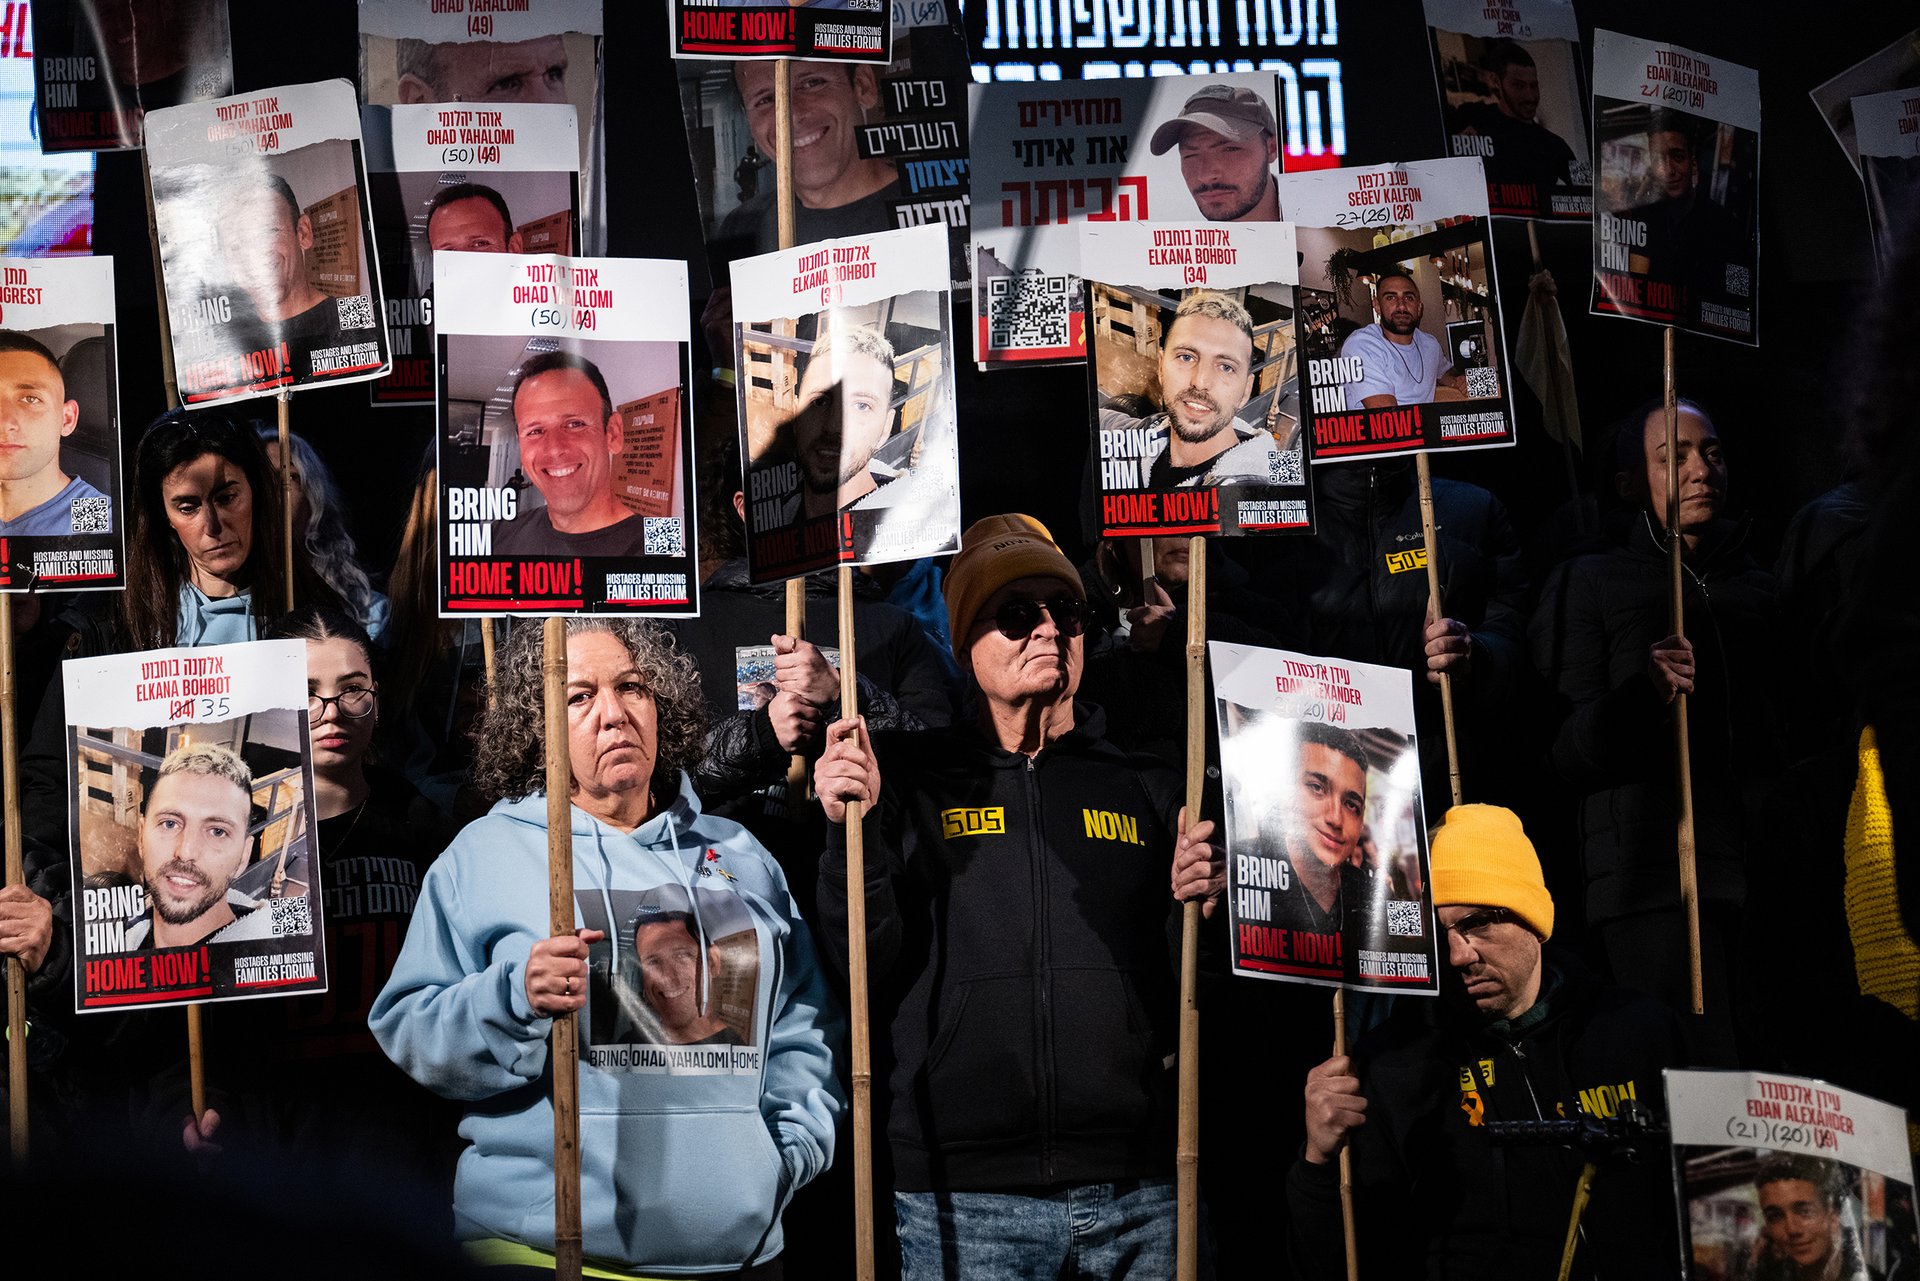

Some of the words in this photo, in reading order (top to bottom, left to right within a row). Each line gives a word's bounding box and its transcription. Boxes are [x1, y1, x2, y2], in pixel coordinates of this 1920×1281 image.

[431, 0, 464, 13] OHAD
[468, 0, 529, 12] YAHALOMI
[1483, 7, 1501, 20] ITAY
[467, 15, 493, 37] (49)
[683, 12, 737, 40] HOME
[741, 9, 796, 41] NOW!
[814, 24, 844, 34] HOSTAGES
[844, 25, 856, 35] AND
[856, 26, 882, 36] MISSING
[814, 33, 851, 49] FAMILIES
[852, 34, 882, 50] FORUM
[43, 57, 96, 81] BRING
[1655, 50, 1692, 71] אלכסנדר
[1693, 62, 1710, 77] עידן
[1647, 65, 1671, 82] EDAN
[1673, 67, 1719, 95] ALEXANDER
[45, 83, 78, 108] HIM
[252, 97, 279, 116] אוהד
[891, 80, 947, 113] פדיון
[216, 102, 250, 122] יהלומי
[438, 110, 473, 127] יהלומי
[475, 112, 502, 127] אוהד
[1018, 97, 1122, 127] מחזירים
[46, 111, 95, 137] HOME
[207, 123, 236, 142] OHAD
[238, 113, 293, 136] YAHALOMI
[1898, 116, 1919, 135] EDAN
[427, 130, 457, 145] OHAD
[459, 129, 515, 144] YAHALOMI
[864, 121, 960, 155] השבויים
[1451, 134, 1495, 157] BRING
[442, 148, 475, 164] (50)
[477, 146, 501, 164] (49)
[1012, 137, 1075, 167] איתי
[1086, 135, 1128, 164] את
[905, 158, 970, 193] יצחון
[1357, 172, 1386, 190] כלפון
[1387, 171, 1409, 186] שגב
[1001, 175, 1149, 227] הביתה
[1348, 190, 1381, 207] SEGEV
[1383, 187, 1422, 204] KALFON
[1500, 182, 1539, 207] NOW!
[1393, 203, 1414, 221] (25)
[1153, 229, 1192, 246] בוחבוט
[1195, 229, 1231, 247] אלקנה
[1600, 210, 1648, 247] BRING
[799, 249, 830, 274] בוחבוט
[833, 245, 870, 264] אלקנה
[1148, 248, 1193, 265] ELKANA
[1194, 248, 1238, 265] BOHBOT
[1601, 241, 1630, 272] HIM
[4, 267, 28, 286] מתן
[527, 264, 566, 283] יהלומי
[568, 267, 599, 287] אוהד
[793, 268, 829, 294] ELKANA
[832, 262, 877, 282] BOHBOT
[1183, 265, 1208, 284] (34)
[513, 286, 549, 304] OHAD
[1600, 272, 1644, 305] HOME
[531, 308, 568, 329] (50)
[571, 307, 597, 331] (49)
[1700, 301, 1722, 314] HOSTAGES
[1701, 310, 1729, 328] FAMILIES
[1729, 316, 1751, 333] FORUM
[239, 341, 290, 381] NOW!
[310, 346, 340, 360] HOSTAGES
[340, 344, 353, 356] AND
[351, 341, 379, 355] MISSING
[311, 355, 350, 373] FAMILIES
[350, 350, 380, 367] FORUM
[1308, 356, 1363, 386] BRING
[1311, 386, 1347, 414] HIM
[1314, 415, 1366, 445] HOME
[1370, 405, 1423, 440] NOW!
[1440, 414, 1467, 424] HOSTAGES
[1467, 413, 1479, 423] AND
[1479, 411, 1504, 421] MISSING
[1441, 423, 1475, 437] FAMILIES
[1477, 420, 1505, 434] FORUM
[1100, 429, 1158, 458] BRING
[750, 461, 798, 501] BRING
[1101, 460, 1139, 490] HIM
[448, 488, 517, 520] BRING
[1103, 493, 1158, 524] HOME
[1162, 487, 1220, 522] NOW!
[1237, 501, 1266, 511] HOSTAGES
[1266, 500, 1280, 510] AND
[1279, 500, 1307, 510] MISSING
[752, 498, 784, 534] HIM
[1238, 510, 1276, 524] FAMILIES
[1276, 510, 1308, 524] FORUM
[448, 523, 492, 556] HIM
[755, 528, 800, 568] HOME
[33, 551, 68, 561] HOSTAGES
[69, 550, 82, 560] AND
[83, 549, 113, 560] MISSING
[34, 560, 78, 577] FAMILIES
[80, 560, 115, 576] FORUM
[451, 562, 512, 594] HOME
[519, 558, 583, 596] NOW!
[606, 574, 641, 585] HOSTAGES
[641, 574, 656, 585] AND
[656, 574, 686, 585] MISSING
[606, 585, 651, 600] FAMILIES
[652, 585, 687, 600] FORUM
[142, 659, 180, 680] בוחבוט
[183, 656, 223, 677] אלקנה
[1282, 660, 1329, 682] אלכסנדר
[1329, 666, 1351, 685] עידן
[137, 679, 179, 702] ELKANA
[183, 676, 231, 697] BOHBOT
[1275, 676, 1303, 694] EDAN
[169, 698, 196, 720] (34)
[201, 697, 230, 717] 35
[945, 809, 1001, 836] SOS
[1083, 808, 1145, 847] NOW.
[335, 856, 419, 887] מחזירים
[1236, 854, 1290, 891] BRING
[83, 884, 145, 921] BRING
[1237, 887, 1272, 922] HIM
[85, 920, 126, 955] HIM
[1239, 924, 1289, 960] HOME
[1292, 931, 1344, 967] NOW!
[234, 956, 269, 968] HOSTAGES
[269, 955, 283, 966] AND
[283, 952, 314, 964] MISSING
[1358, 950, 1387, 962] HOSTAGES
[1387, 951, 1400, 962] AND
[1400, 952, 1427, 964] MISSING
[85, 956, 147, 993] HOME
[151, 945, 211, 988] NOW!
[235, 967, 279, 984] FAMILIES
[279, 962, 315, 980] FORUM
[1359, 960, 1396, 977] FAMILIES
[1397, 963, 1428, 979] FORUM
[589, 1050, 628, 1067] BRING
[632, 1050, 666, 1067] OHAD
[670, 1051, 729, 1069] YAHALOMI
[731, 1052, 759, 1070] HOME
[1757, 1080, 1814, 1105] אלכסנדר
[1816, 1089, 1841, 1111] עידן
[1746, 1099, 1782, 1119] EDAN
[1785, 1104, 1855, 1135] ALEXANDER
[1726, 1116, 1770, 1143] (21)
